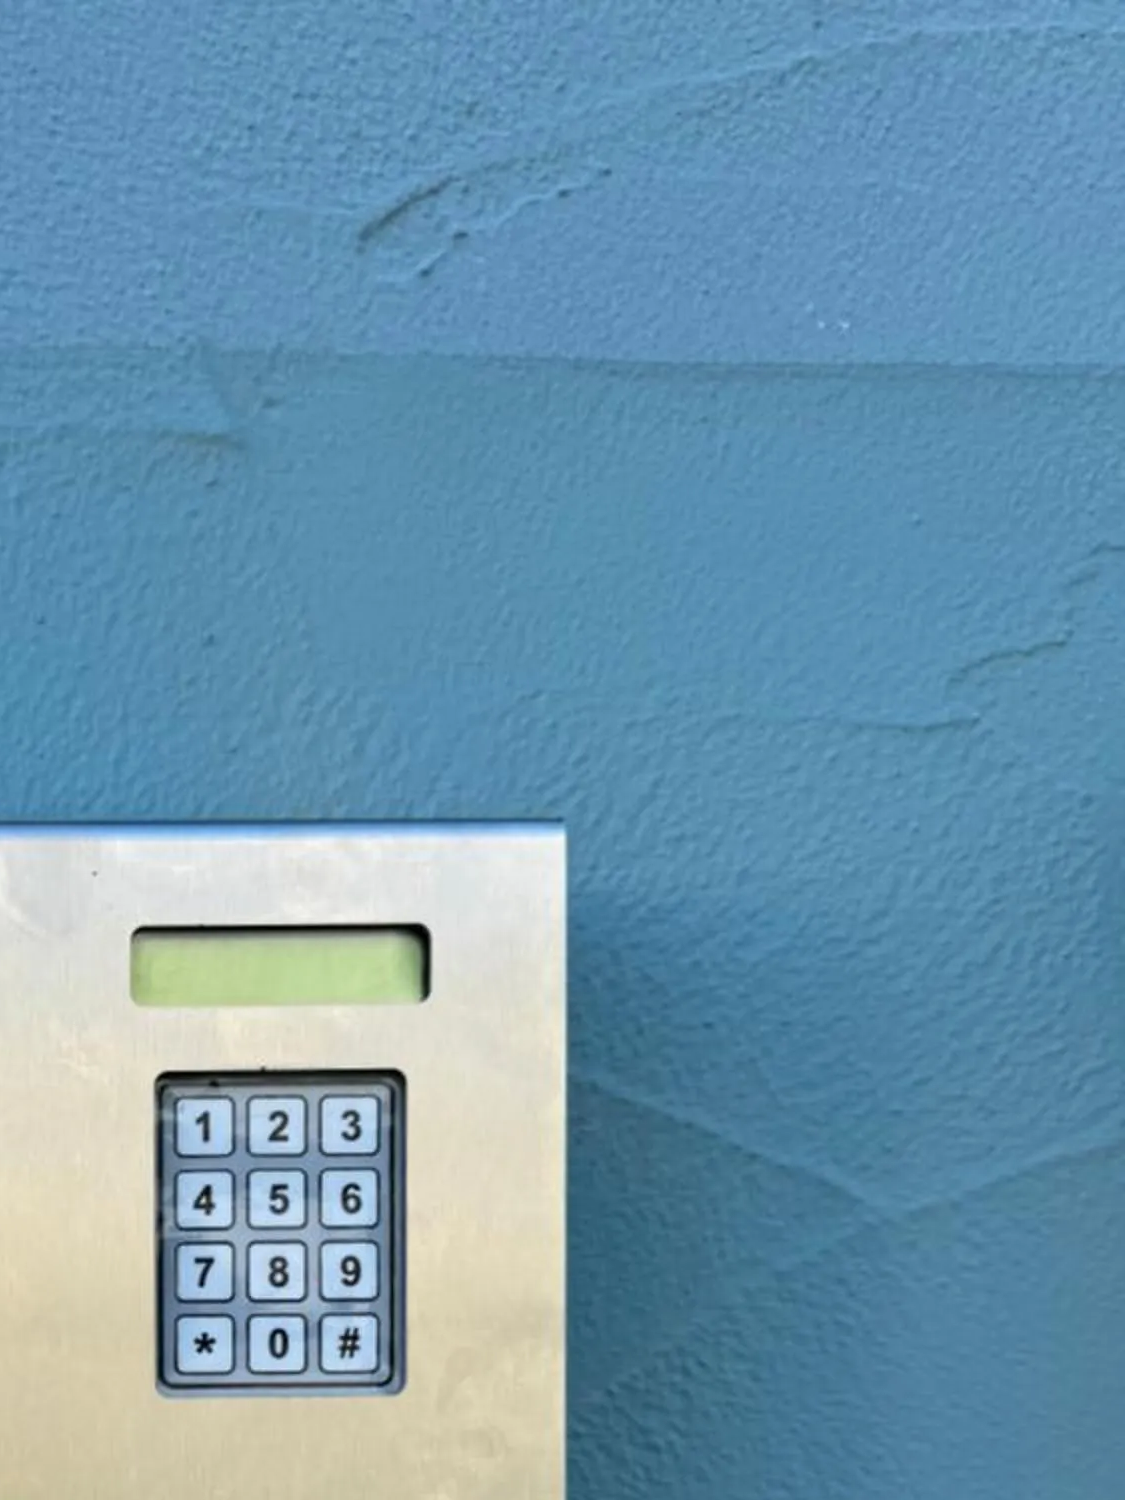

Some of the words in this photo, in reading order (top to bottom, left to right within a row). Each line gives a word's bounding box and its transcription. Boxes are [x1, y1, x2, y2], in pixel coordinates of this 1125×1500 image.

[194, 1111, 211, 1142] 1
[268, 1110, 290, 1142] 2
[341, 1110, 362, 1142] 3
[192, 1184, 215, 1216] 4
[269, 1184, 290, 1216] 5
[341, 1183, 362, 1215] 6
[194, 1257, 215, 1288] 7
[268, 1256, 290, 1288] 8
[341, 1255, 362, 1287] 9
[268, 1328, 290, 1359] 0
[338, 1327, 362, 1359] #
